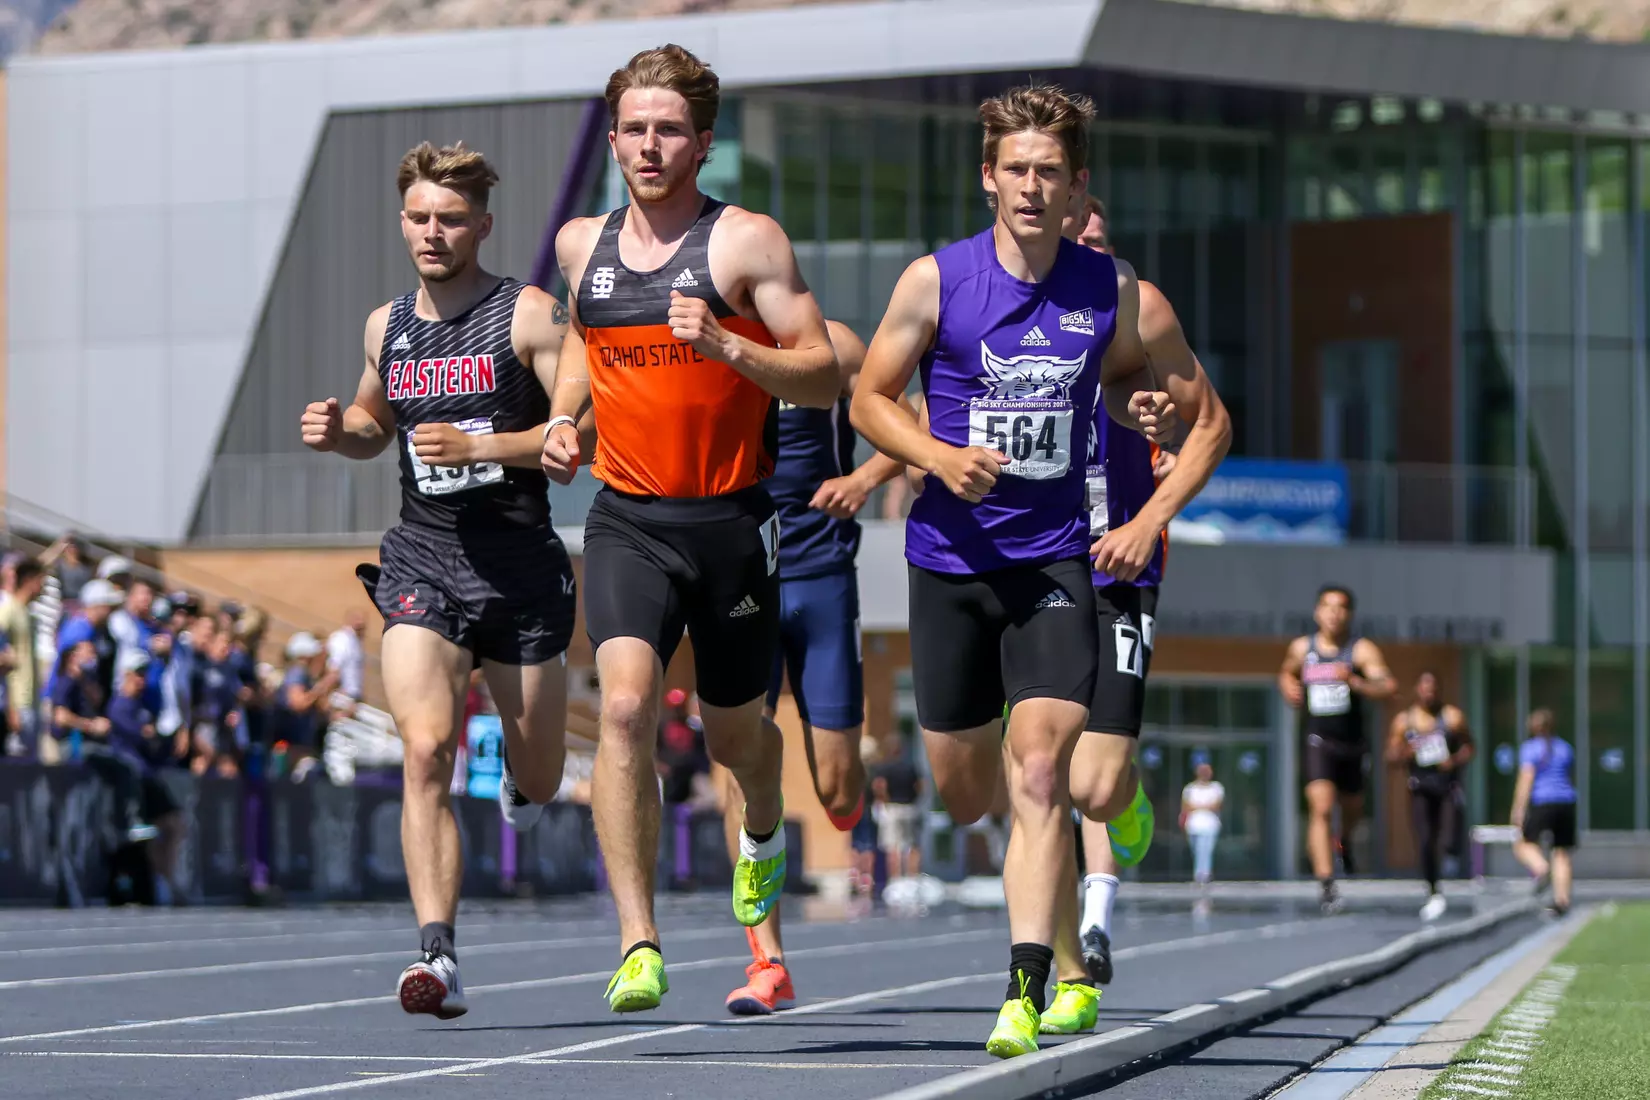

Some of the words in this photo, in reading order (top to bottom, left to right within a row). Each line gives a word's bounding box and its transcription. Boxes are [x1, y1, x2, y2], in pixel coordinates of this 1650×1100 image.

[671, 278, 698, 289] adidas
[391, 342, 411, 350] adidas
[1020, 338, 1051, 346] adidas
[649, 342, 704, 366] STATE
[387, 353, 496, 400] EASTERN
[986, 416, 1057, 460] 564
[1035, 599, 1076, 609] adidas
[729, 604, 760, 618] adidas
